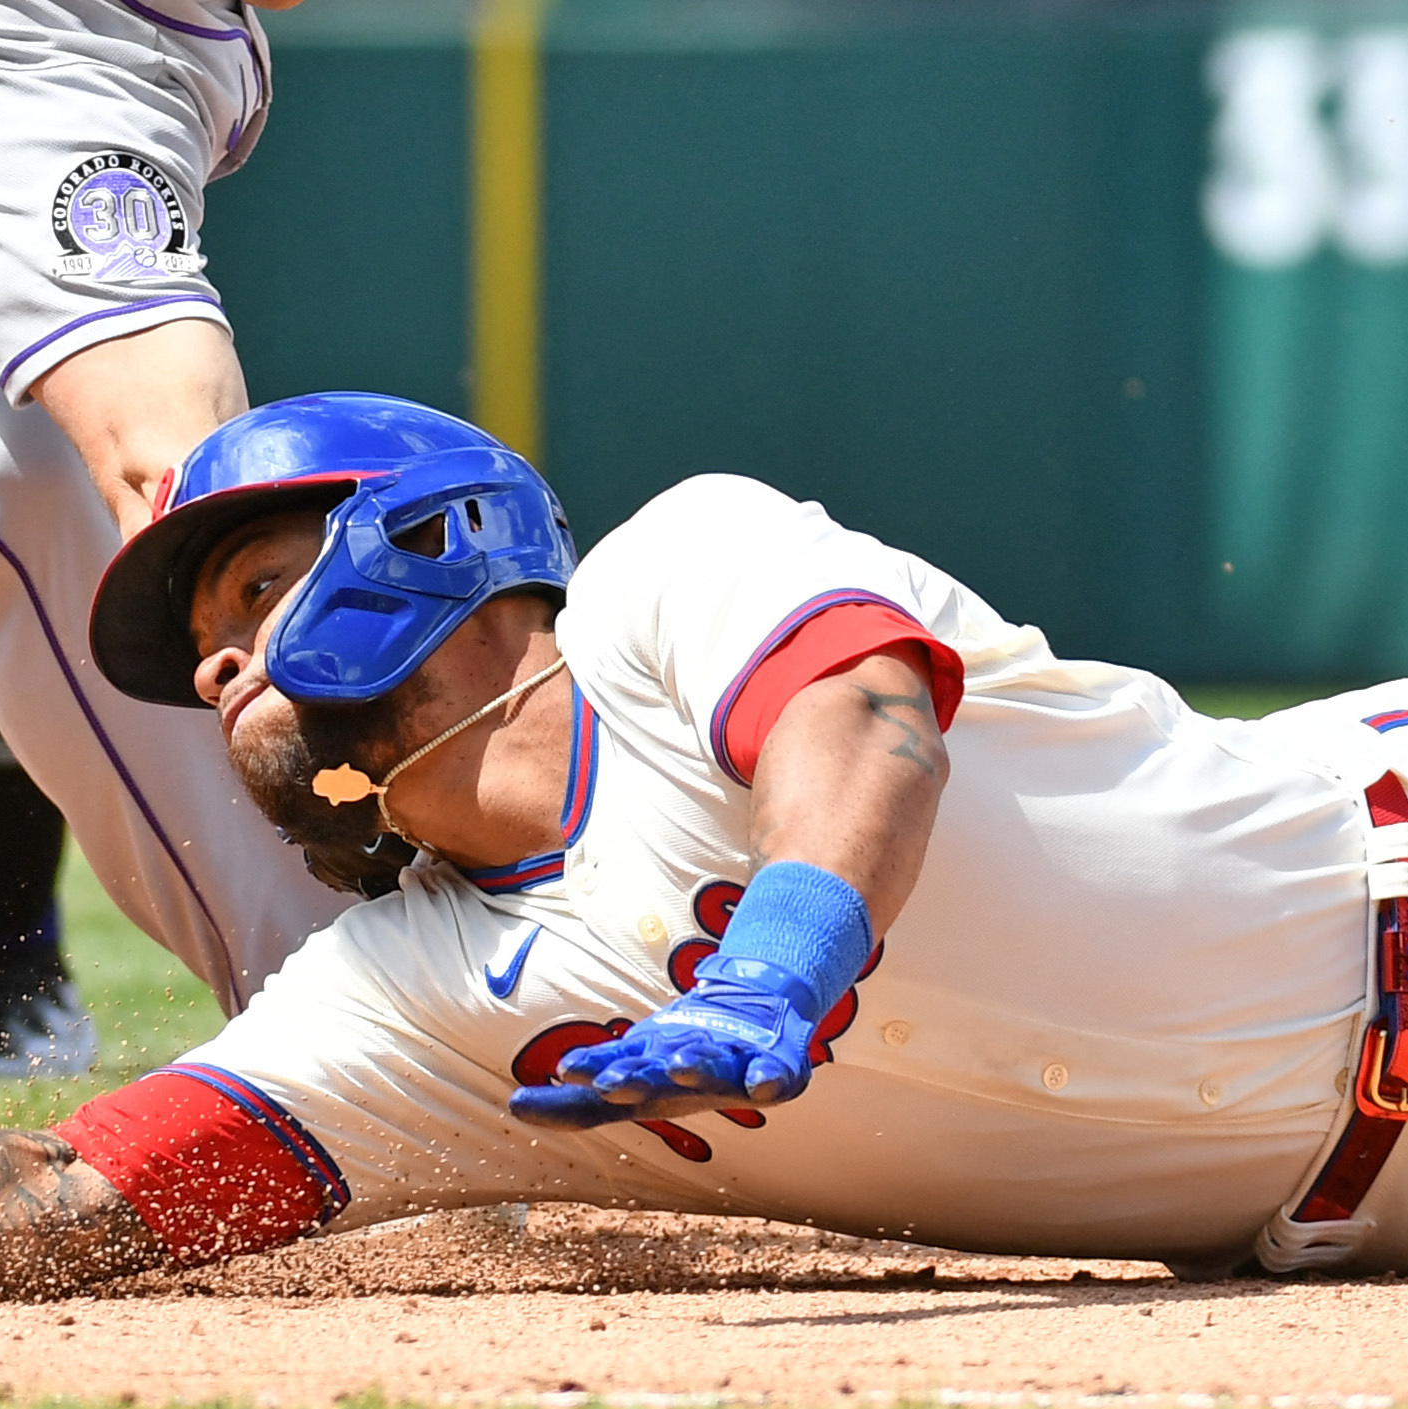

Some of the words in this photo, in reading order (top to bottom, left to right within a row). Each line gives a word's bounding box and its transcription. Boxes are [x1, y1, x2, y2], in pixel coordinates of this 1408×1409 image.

[53, 154, 120, 231] COLORADO
[129, 158, 185, 231] ROCKIES
[78, 186, 161, 243] 30
[62, 256, 92, 271] 1993
